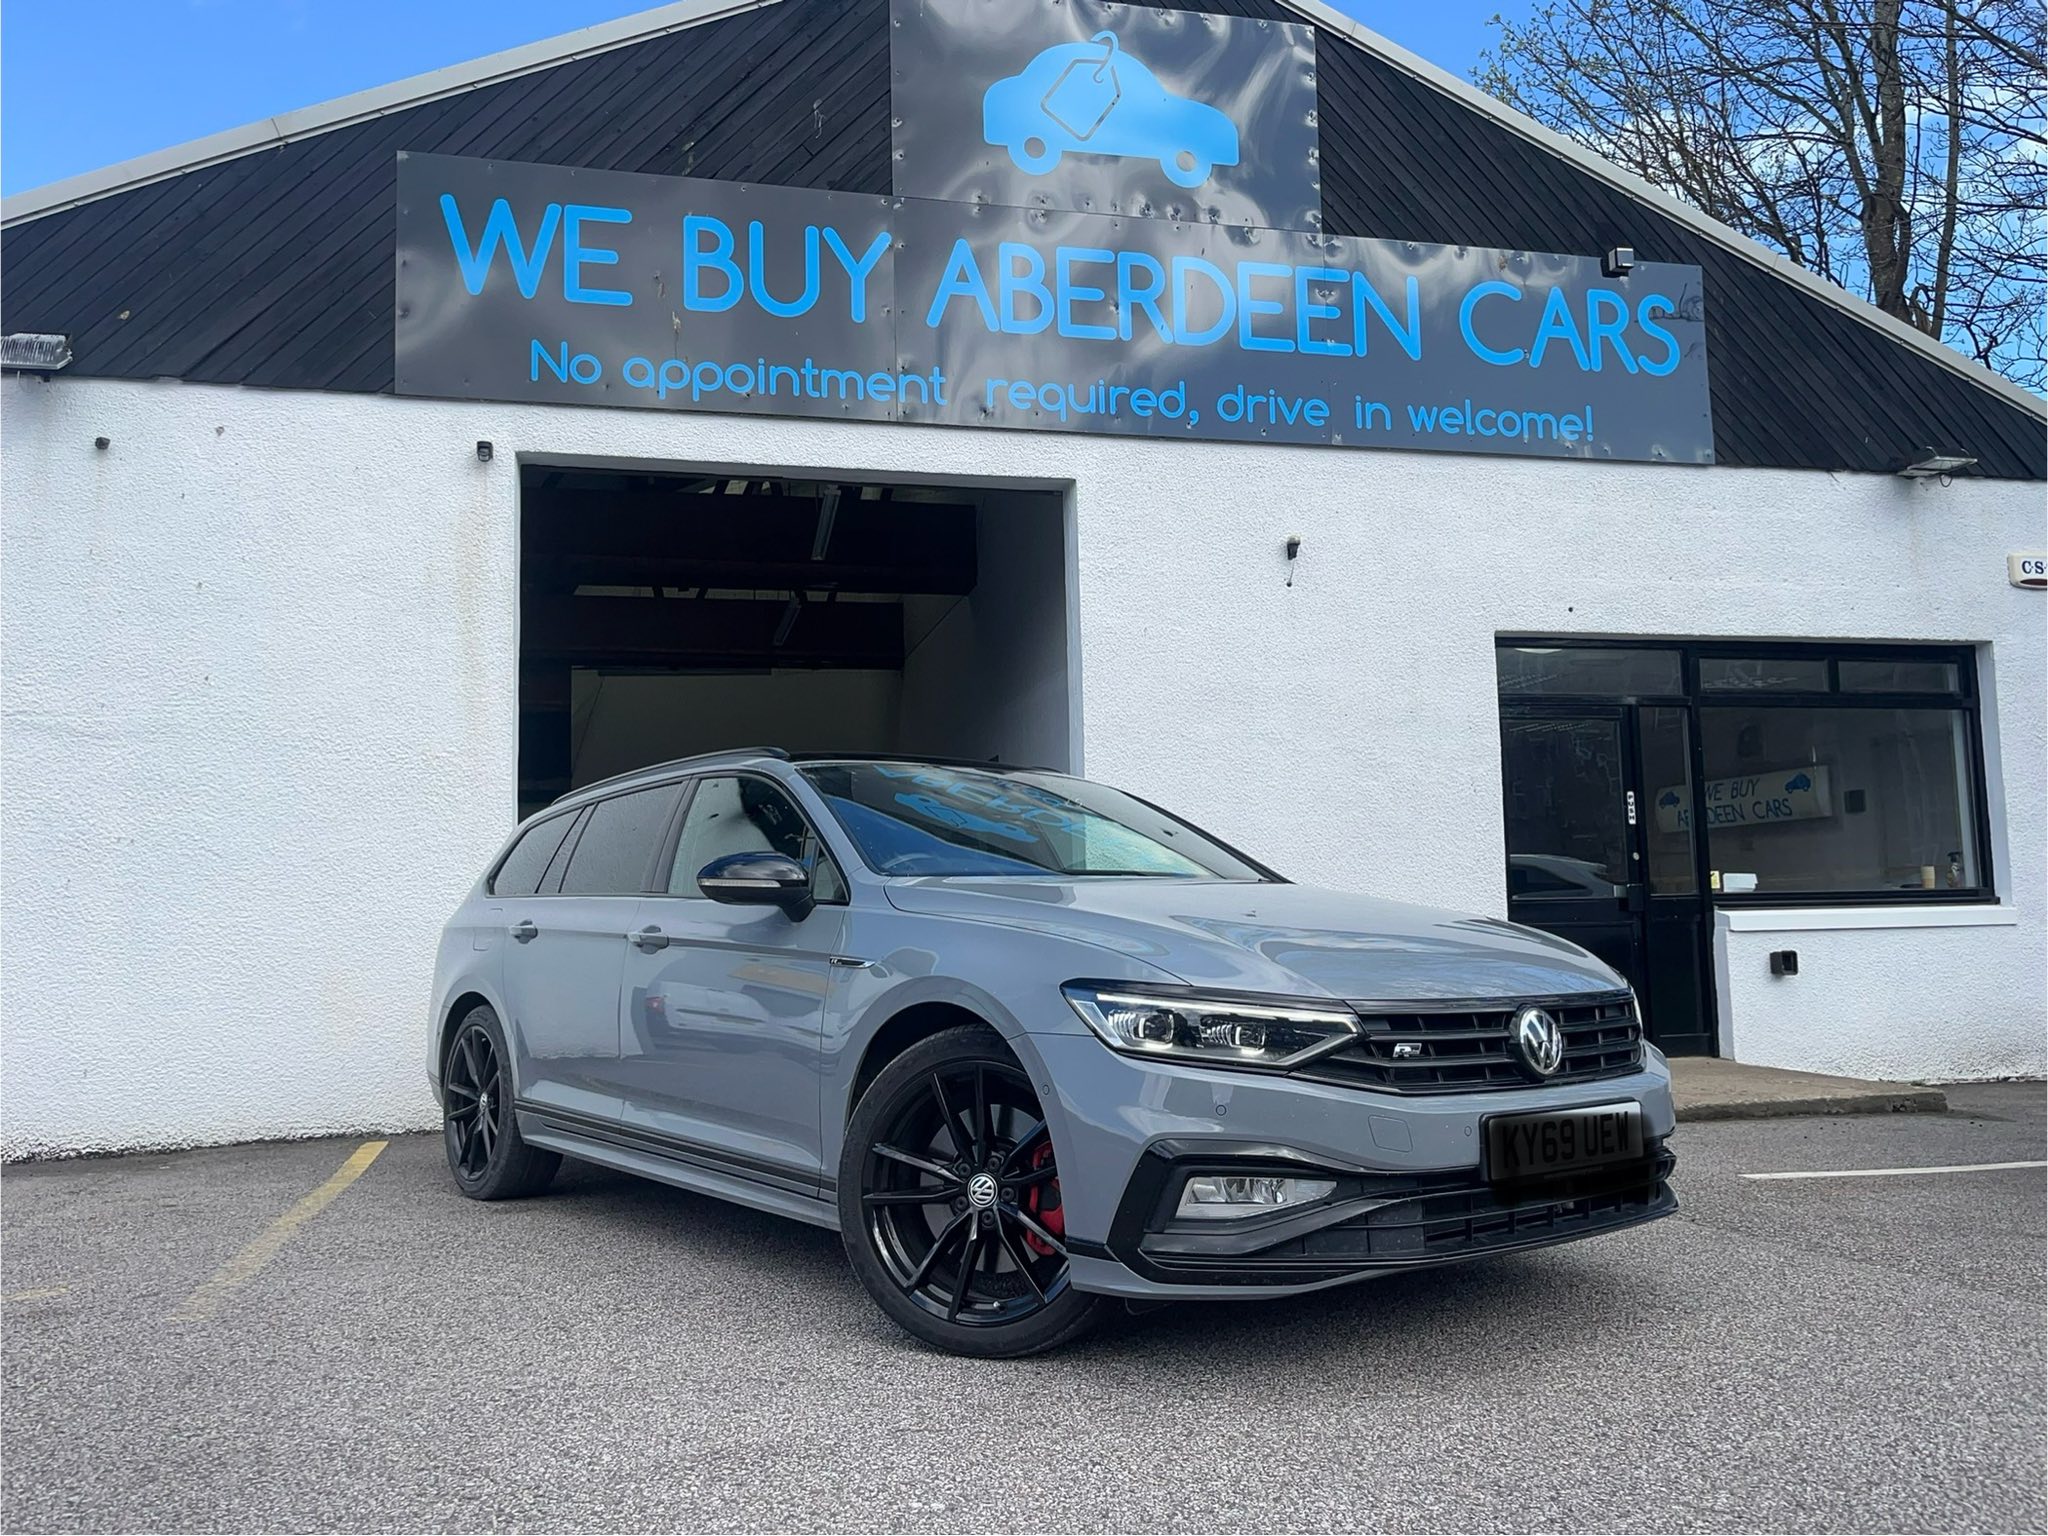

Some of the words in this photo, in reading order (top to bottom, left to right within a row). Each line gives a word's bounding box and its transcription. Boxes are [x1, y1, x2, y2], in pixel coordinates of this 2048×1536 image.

[439, 193, 634, 306] WE
[682, 213, 893, 323] BUY
[925, 237, 1423, 362] ABERDEEN
[1457, 279, 1682, 378] CARS
[530, 338, 603, 385] No
[622, 355, 947, 406] appointment
[986, 376, 1201, 427] required,
[1216, 383, 1331, 427] drive
[1354, 394, 1393, 431] in
[1406, 397, 1596, 443] welcome!
[1730, 777, 1760, 799] BUY
[1752, 798, 1793, 819] CARS
[1502, 1119, 1575, 1169] KY69
[1584, 1111, 1629, 1157] UEW
